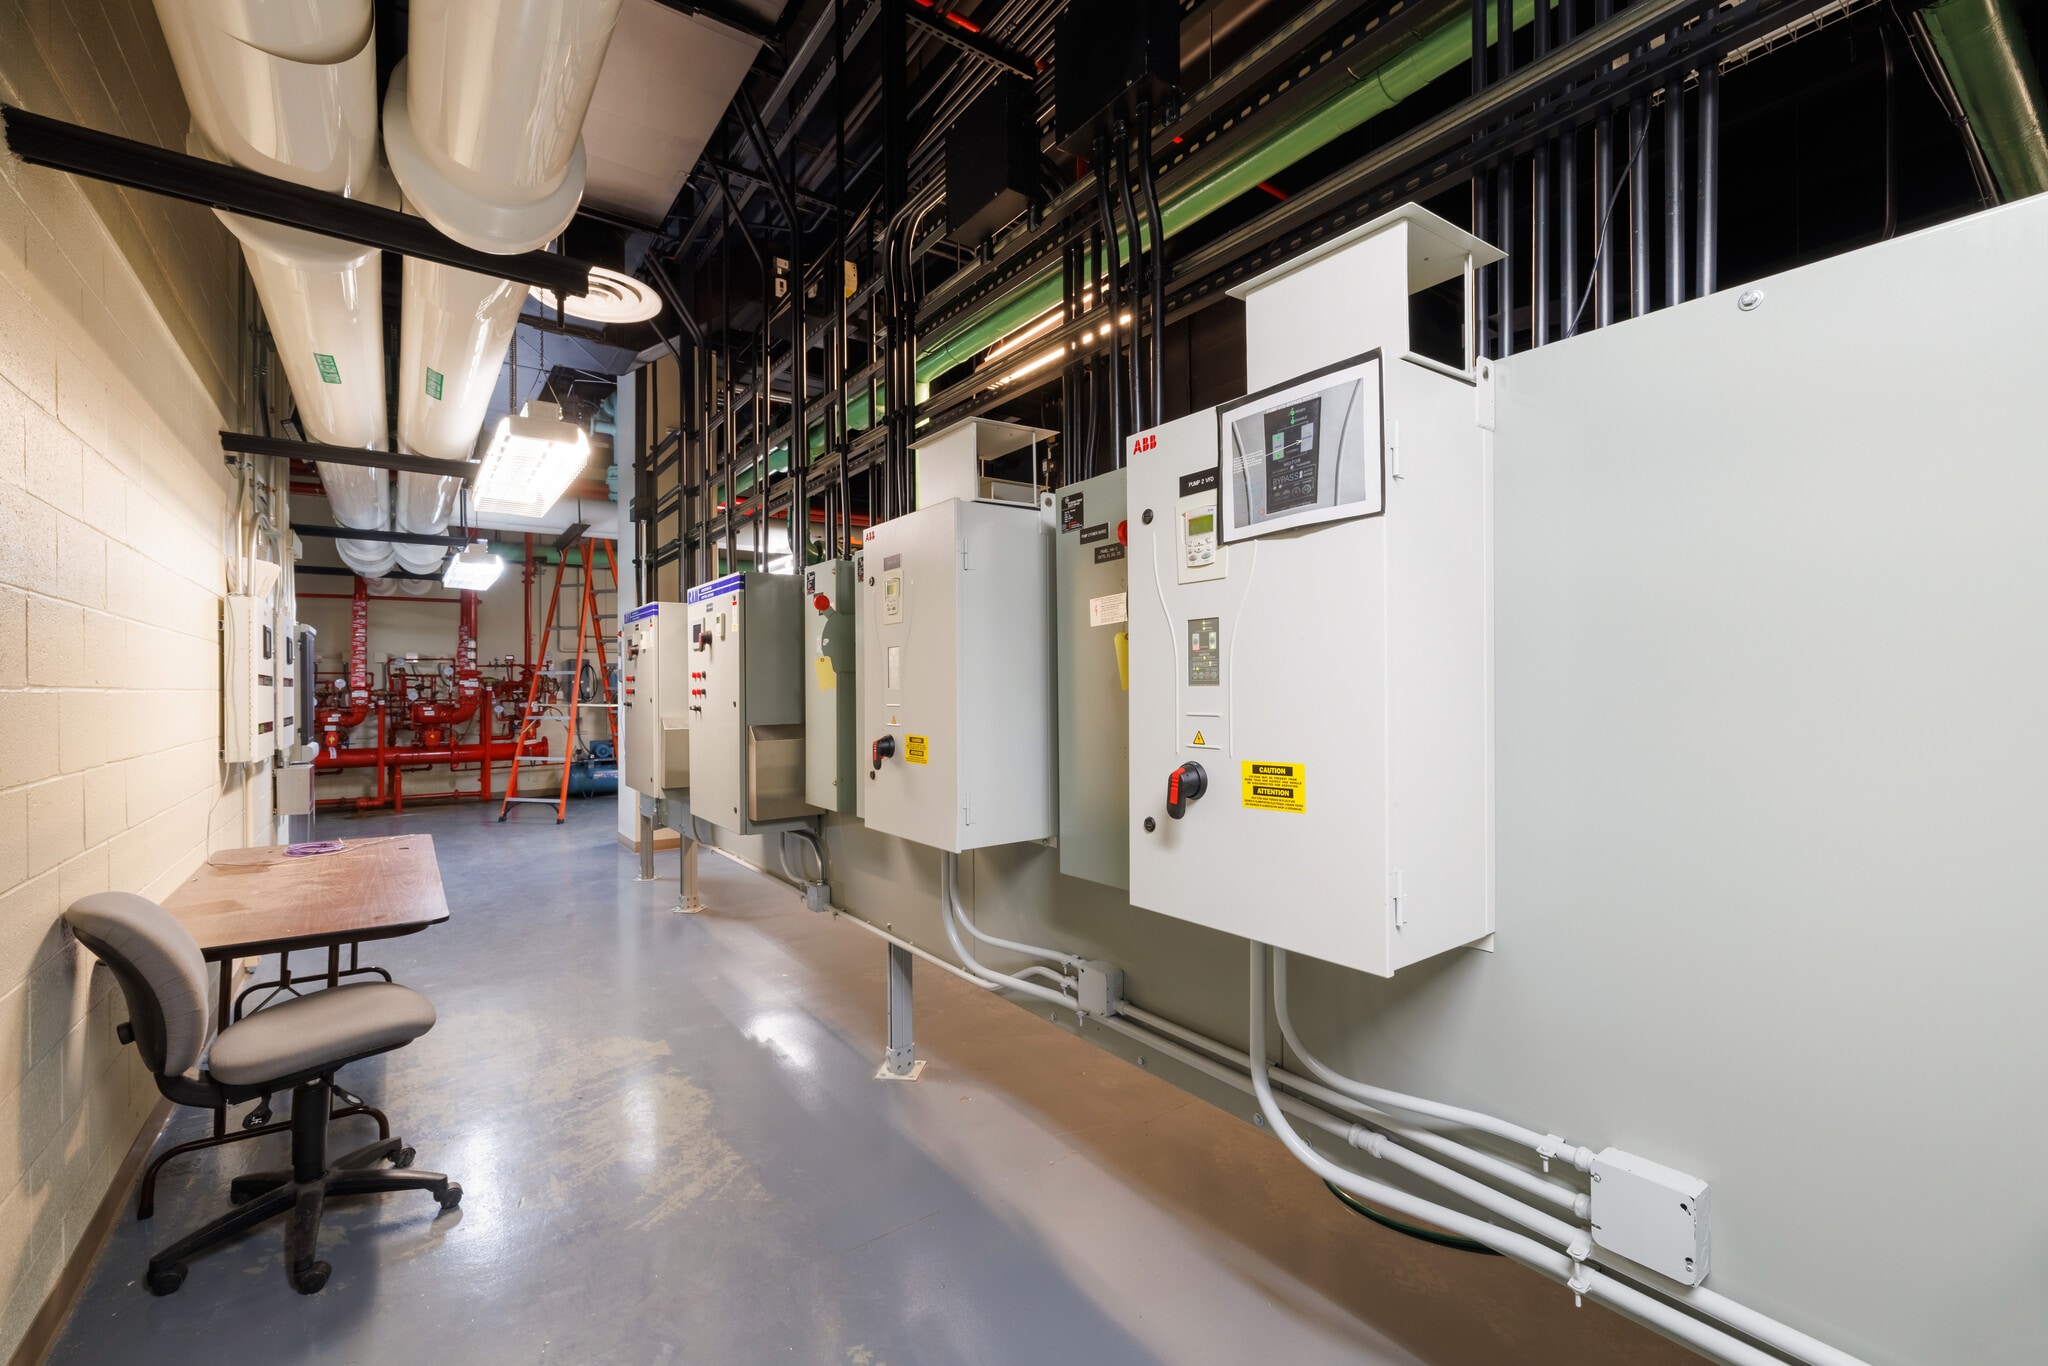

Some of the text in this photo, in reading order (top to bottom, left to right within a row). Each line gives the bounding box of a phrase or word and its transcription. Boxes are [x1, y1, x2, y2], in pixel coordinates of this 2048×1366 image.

[1133, 434, 1157, 455] ABB
[1188, 479, 1201, 488] PUMP
[1205, 475, 1215, 483] VFD
[1272, 471, 1299, 486] BYPASS
[866, 531, 875, 542] ABB
[1258, 766, 1286, 775] CAUTION
[1256, 788, 1290, 797] ATTENTION
